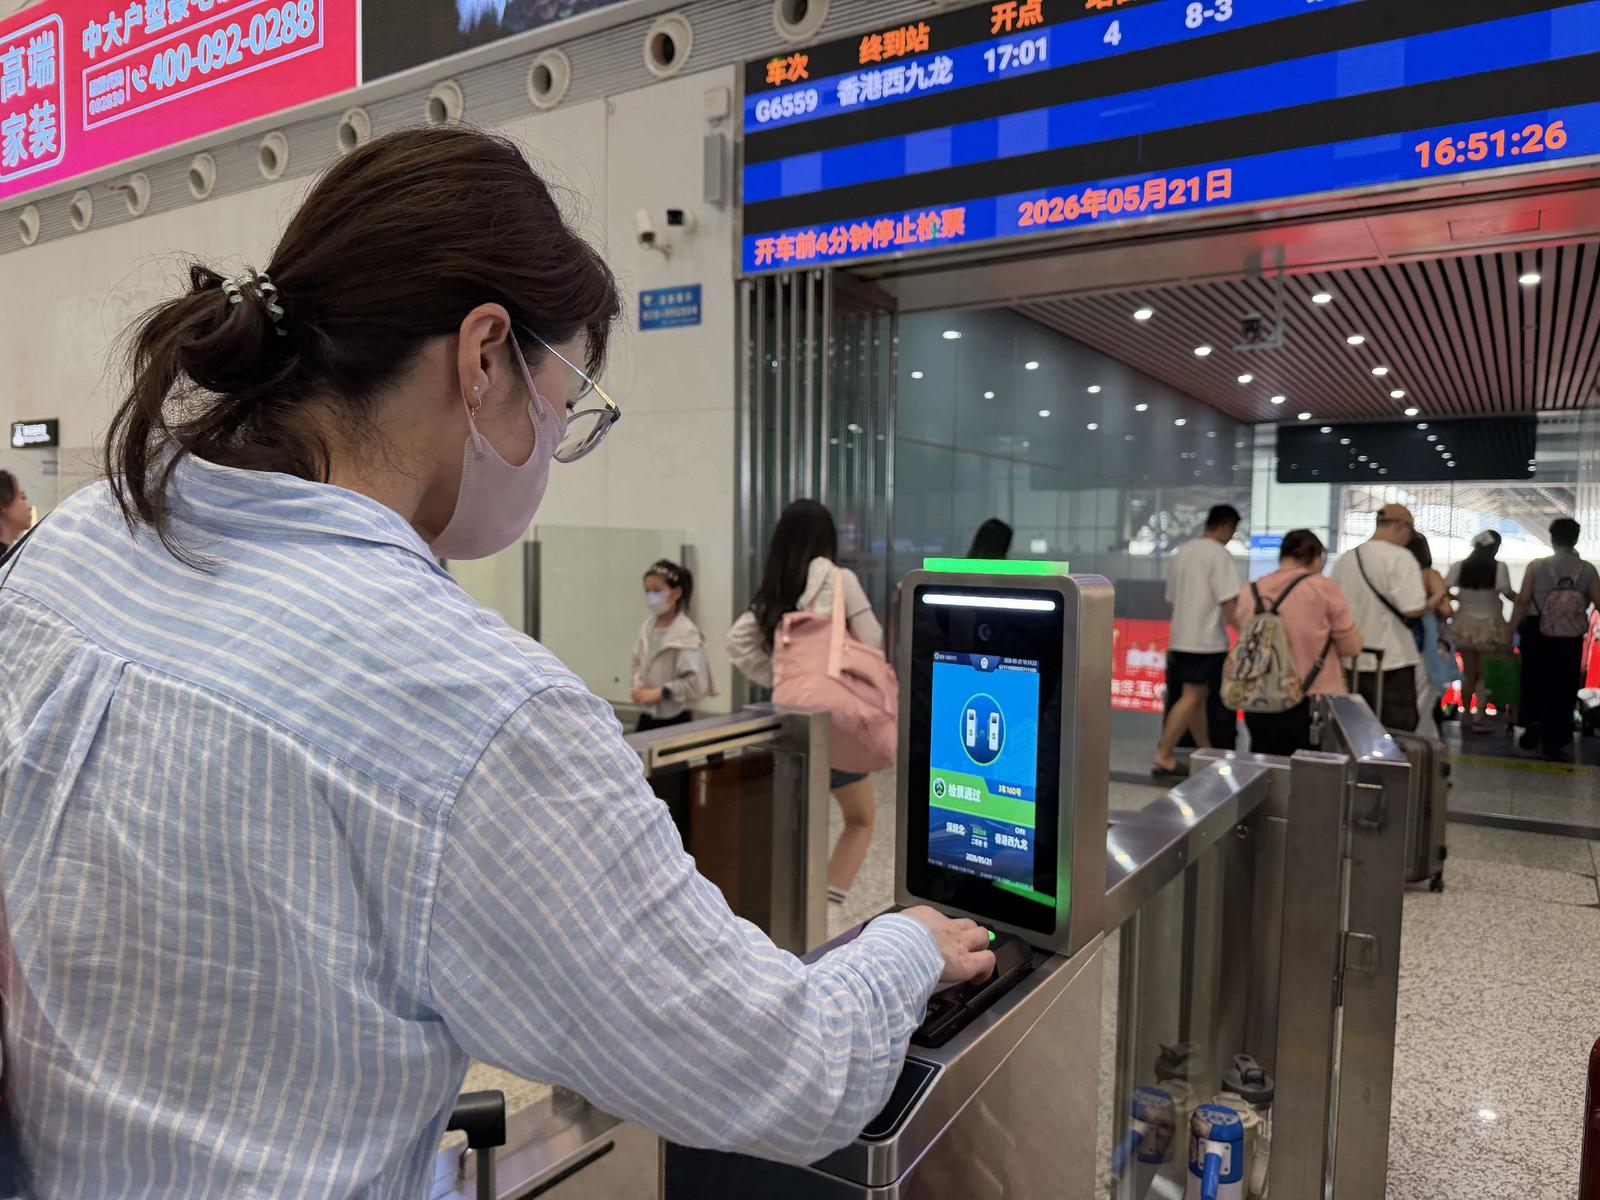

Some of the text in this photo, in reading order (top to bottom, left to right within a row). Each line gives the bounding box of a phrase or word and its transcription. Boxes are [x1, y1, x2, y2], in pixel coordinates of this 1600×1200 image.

[990, 0, 1043, 34] 开点
[1104, 20, 1121, 46] 4
[1185, 0, 1233, 28] 8-3
[0, 30, 56, 101] 高端
[149, 0, 315, 90] 400-092-0288
[859, 23, 930, 64] 终到站
[984, 37, 1047, 73] 17:01
[766, 54, 809, 86] 车次
[836, 56, 954, 106] 香港西九龙
[755, 89, 818, 123] G6559
[1, 100, 57, 168] 家装
[1415, 120, 1567, 168] 16:51:26
[1018, 168, 1232, 227] 2026年05月21日
[754, 207, 966, 267] 开车前4分钟停止检票
